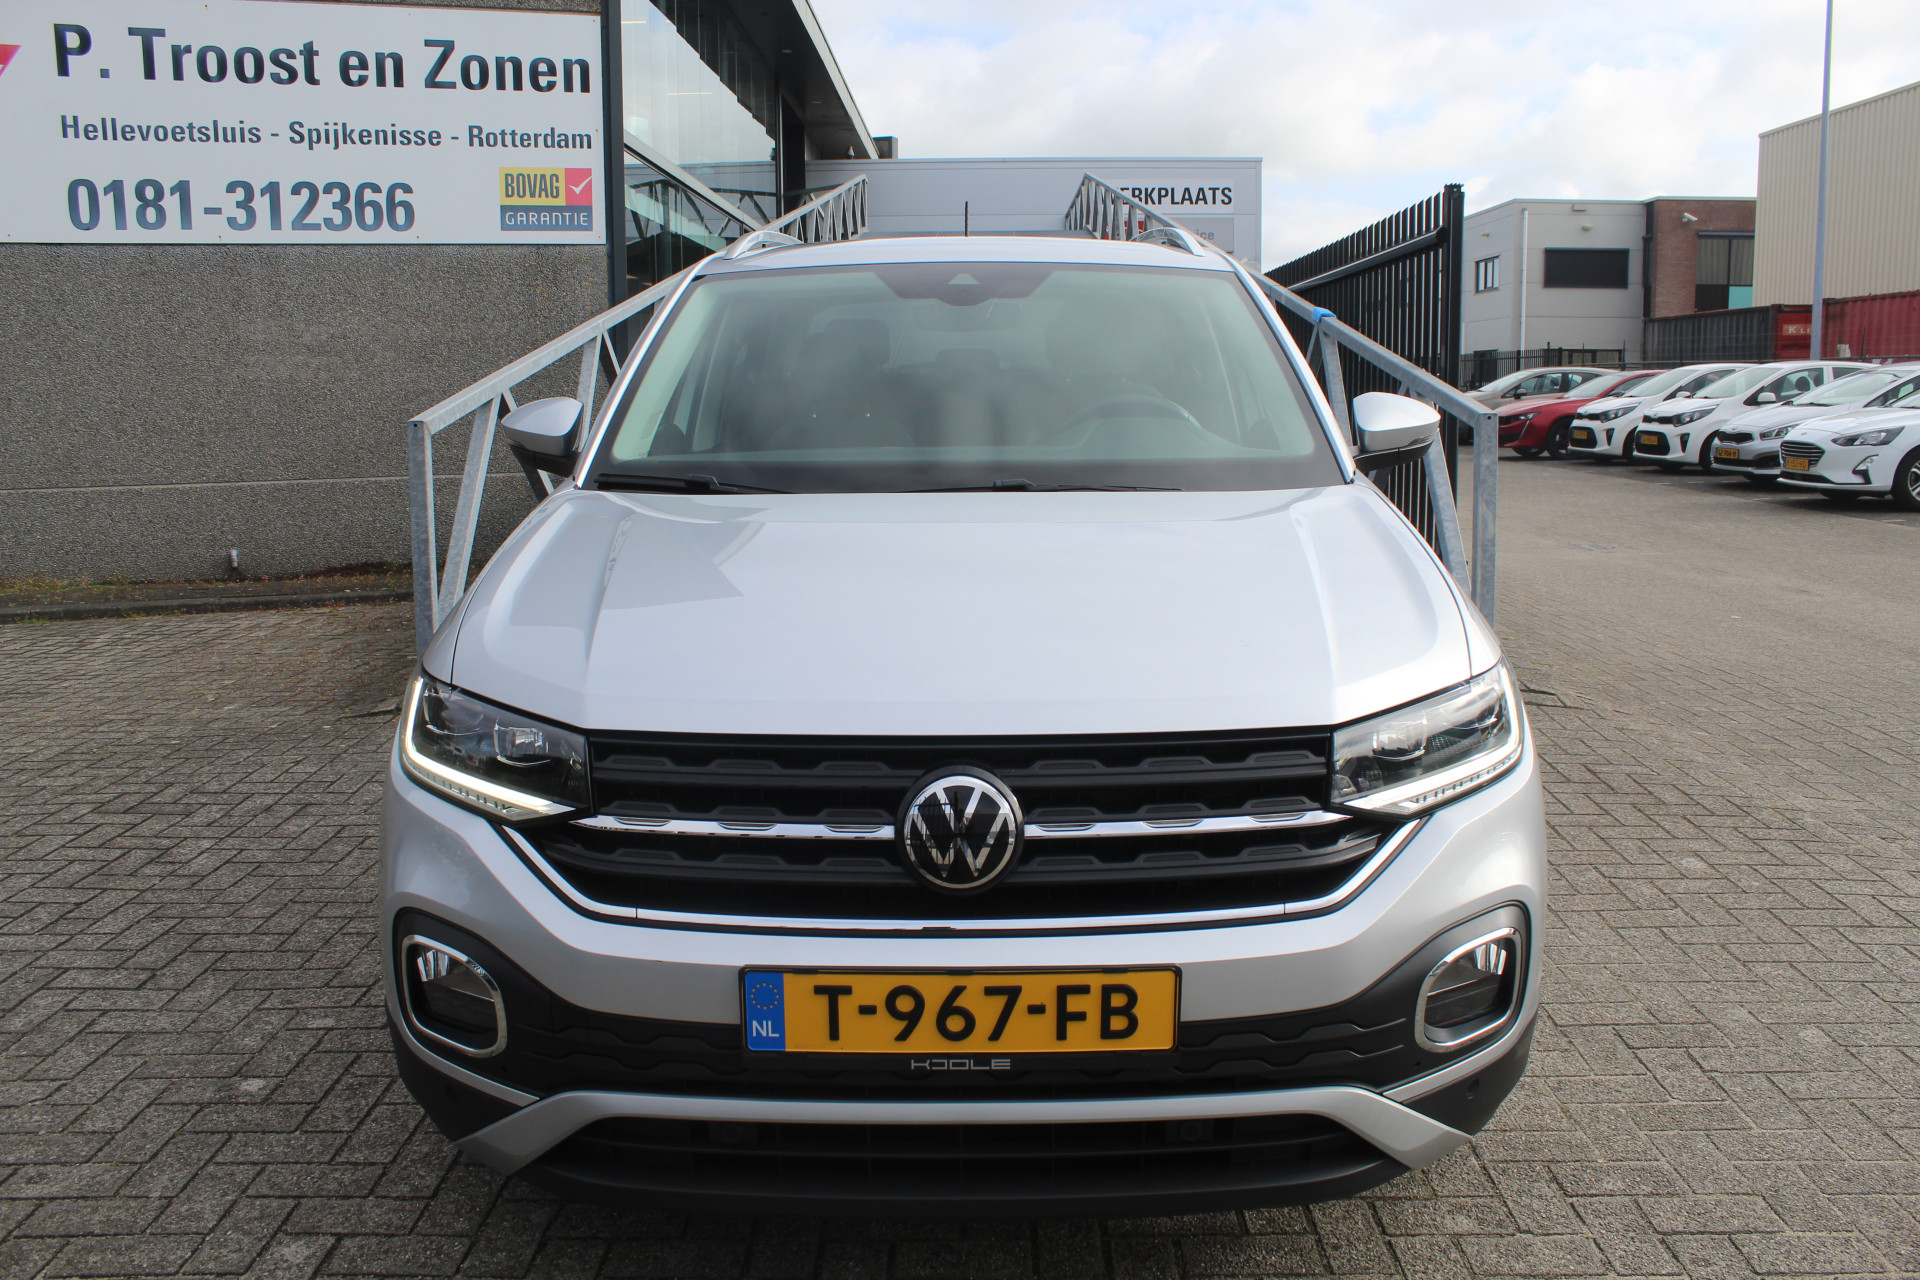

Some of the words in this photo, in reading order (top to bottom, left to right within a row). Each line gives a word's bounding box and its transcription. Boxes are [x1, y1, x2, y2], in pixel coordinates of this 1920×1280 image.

[53, 23, 110, 78] P.
[128, 27, 320, 87] Troost
[339, 46, 404, 88] en
[423, 39, 591, 94] Zonen
[60, 114, 262, 145] Hellevoetsluis
[288, 121, 442, 150] Spijkenisse
[467, 125, 592, 150] Rotterdam
[503, 172, 560, 200] BOVAG
[1101, 186, 1233, 206] RKPLAATS
[67, 178, 416, 232] 0181-312366
[505, 209, 589, 227] GARANTIE
[752, 1020, 780, 1038] NL
[813, 984, 1139, 1042] T-967-FB
